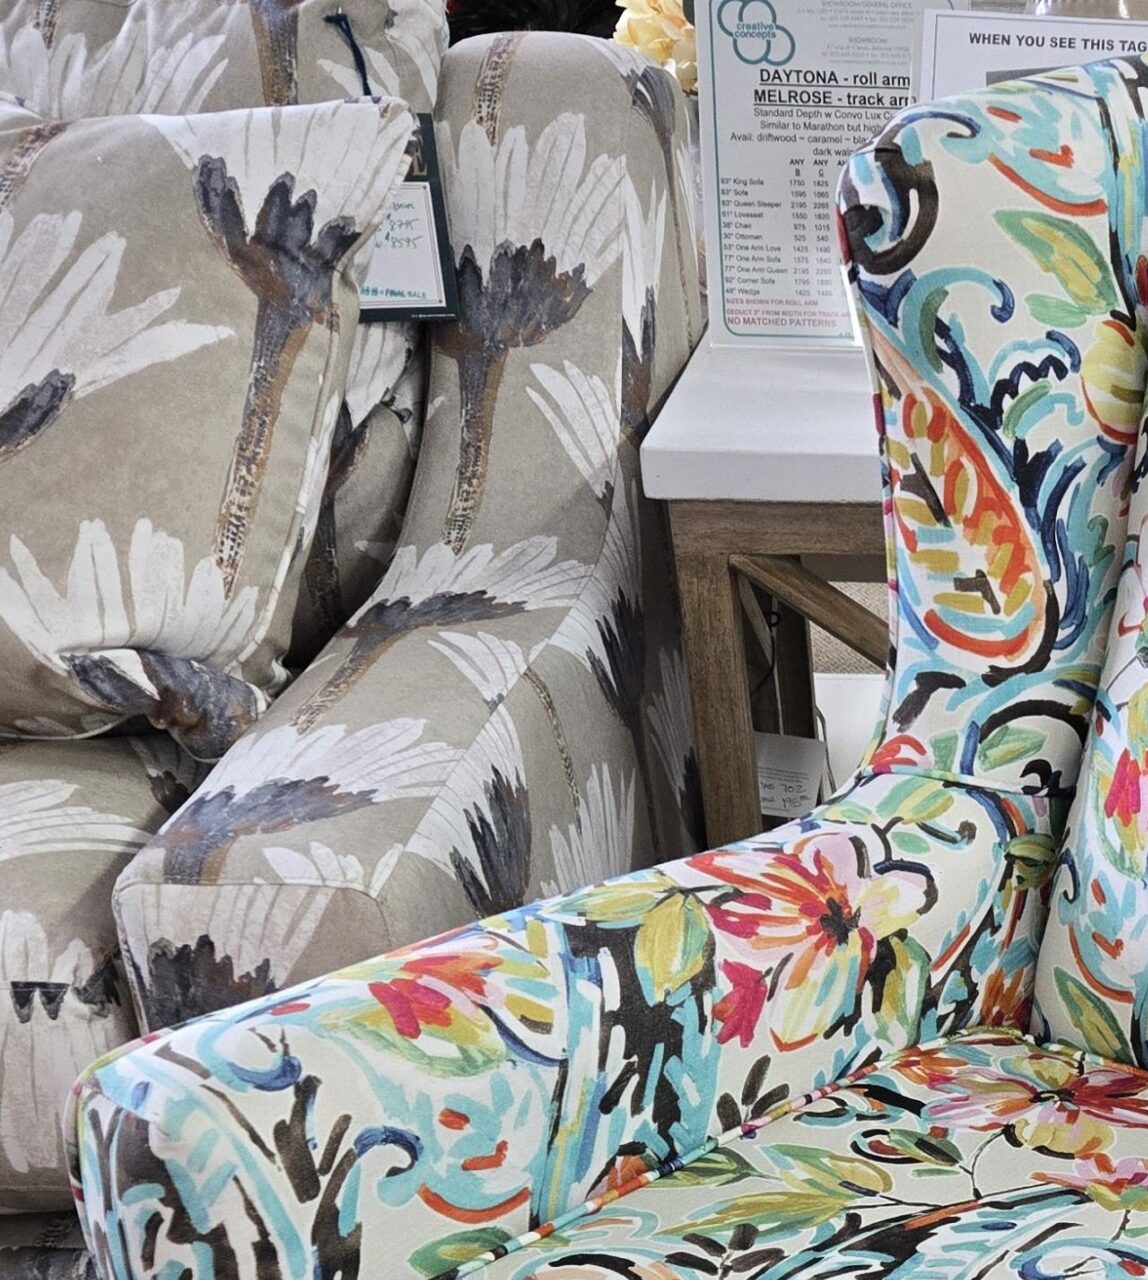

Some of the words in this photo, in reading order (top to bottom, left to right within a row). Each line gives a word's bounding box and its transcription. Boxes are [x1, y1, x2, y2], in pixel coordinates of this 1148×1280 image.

[736, 21, 774, 30] creative
[734, 31, 777, 40] concepts
[969, 32, 1011, 45] WHEN
[1016, 34, 1045, 47] YOU
[1050, 37, 1076, 49] SEE
[1081, 39, 1114, 51] THIS
[759, 69, 839, 84] DAYTONA
[853, 72, 877, 85] roll
[882, 74, 911, 86] arm
[753, 89, 832, 104] MELROSE
[847, 92, 885, 106] track
[753, 108, 793, 118] Standard
[796, 110, 822, 120] Depth
[834, 110, 863, 120] Convo
[865, 111, 881, 120] Lux
[760, 121, 790, 130] Similar
[792, 122, 800, 131] to
[803, 123, 845, 132] Marathon
[847, 123, 862, 132] but
[730, 133, 754, 143] Avail:
[757, 134, 797, 143] driftwood
[807, 136, 843, 144] caramel
[813, 147, 831, 156] dark
[733, 178, 748, 186] King
[749, 178, 765, 186] Sofa
[734, 200, 756, 208] Queen
[734, 211, 764, 219] Loveseat
[734, 221, 752, 229] Chair
[734, 232, 763, 240] Ottoman
[735, 243, 750, 251] One
[736, 254, 750, 262] One
[737, 265, 750, 273] One
[737, 287, 761, 296] Wedge
[727, 316, 741, 326] NO
[742, 316, 787, 327] MATCHED
[788, 318, 837, 328] PATTERNS
